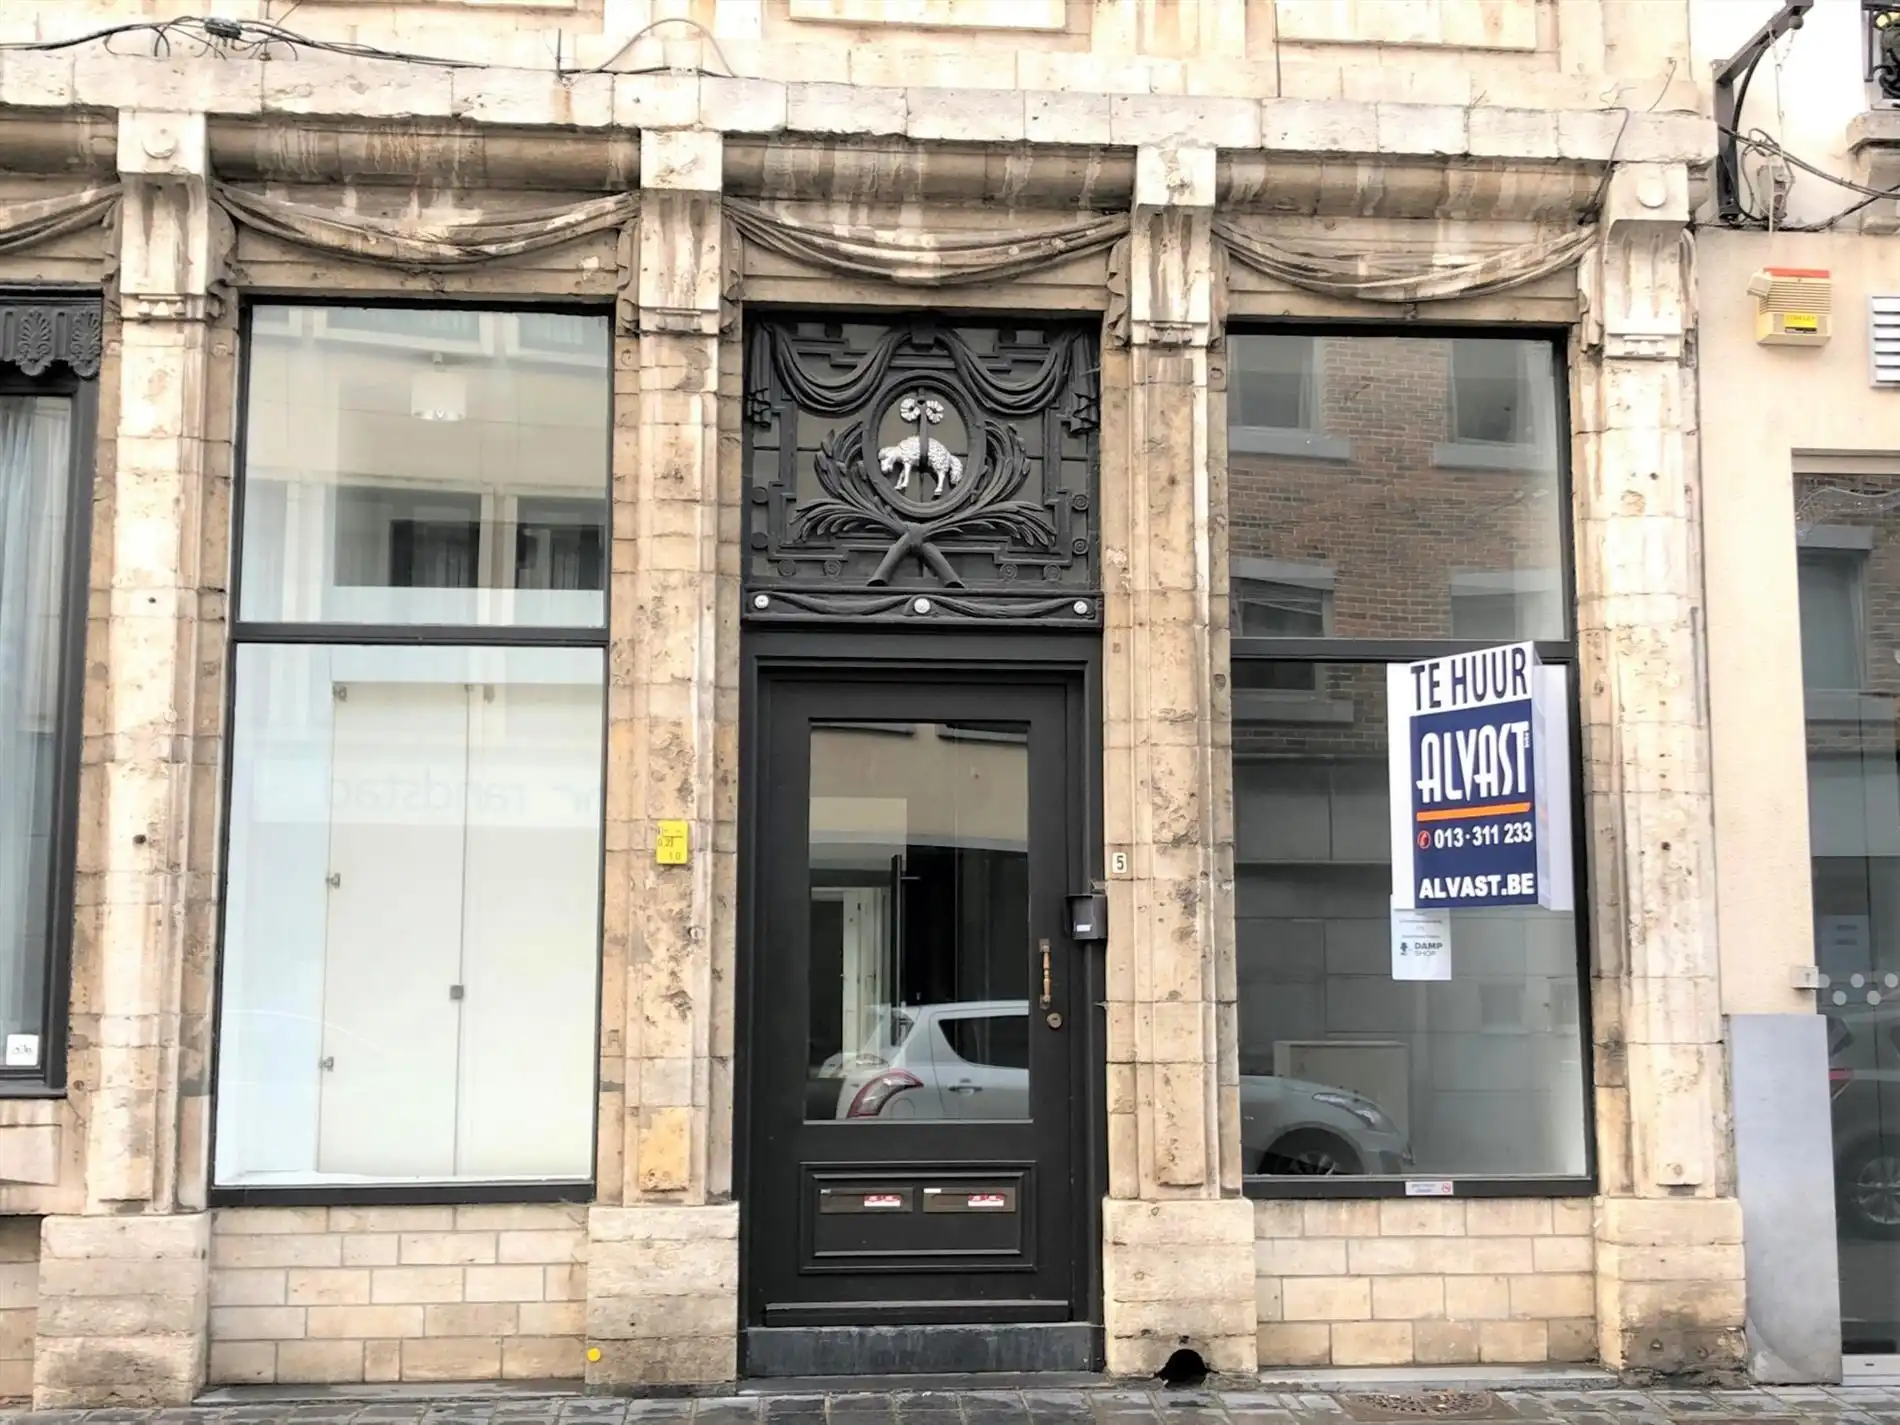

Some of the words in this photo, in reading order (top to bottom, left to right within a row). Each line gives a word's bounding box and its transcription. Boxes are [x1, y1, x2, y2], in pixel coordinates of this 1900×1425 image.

[1410, 662, 1441, 711] TE
[1451, 647, 1528, 705] HUUR
[1416, 721, 1530, 803] ALVAST
[1504, 822, 1533, 844] 233
[1116, 855, 1124, 870] 5
[1418, 872, 1535, 900] ALVAST.BE
[1414, 941, 1443, 951] DAMP
